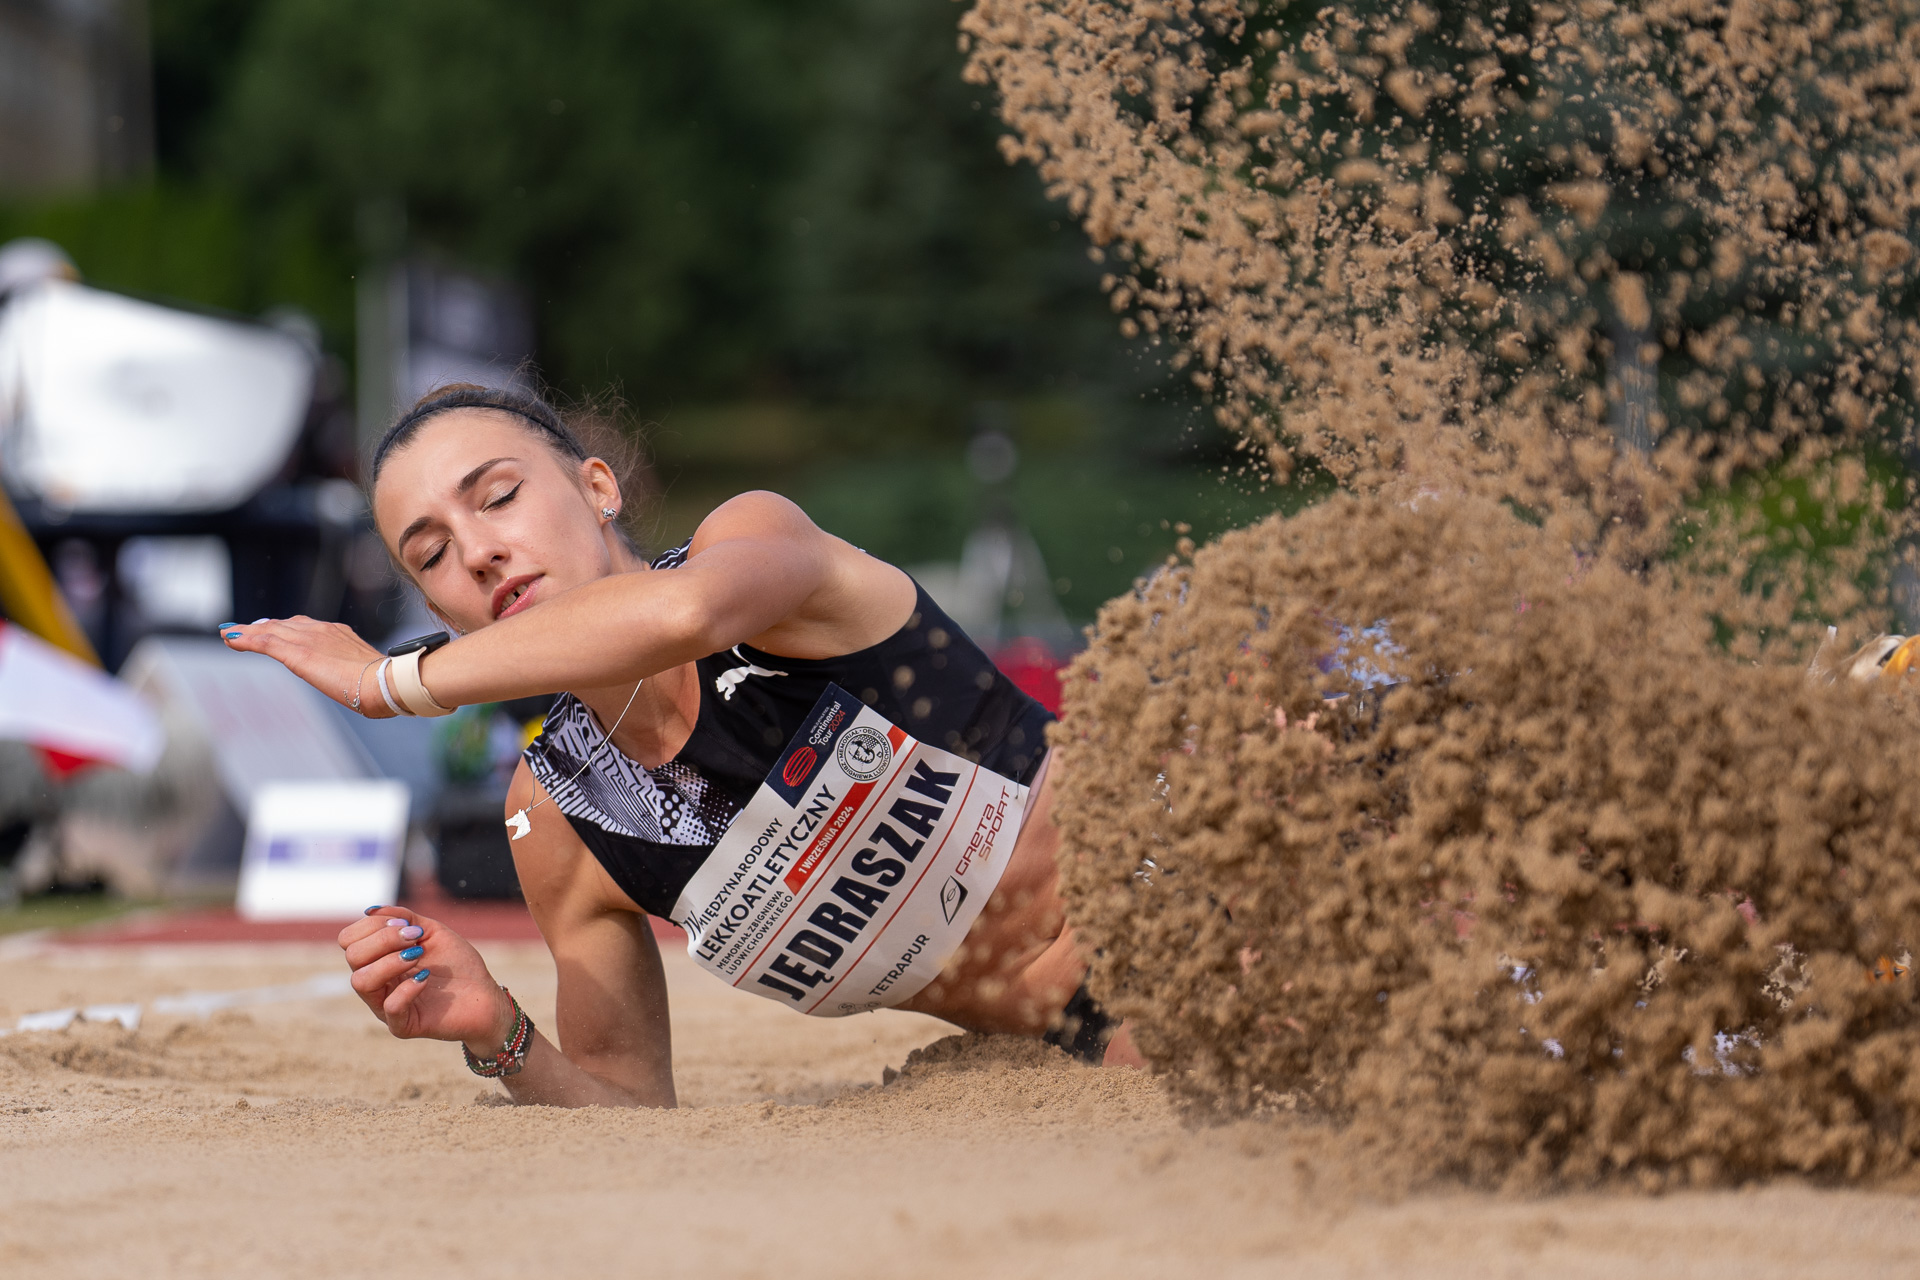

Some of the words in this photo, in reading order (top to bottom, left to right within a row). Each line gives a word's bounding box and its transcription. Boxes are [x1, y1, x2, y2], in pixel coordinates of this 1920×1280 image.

[809, 700, 842, 745] Continental
[817, 729, 834, 746] Tour
[828, 710, 846, 732] 2024
[841, 761, 874, 779] ZBIGNIEWA
[833, 805, 855, 829] 2024
[978, 784, 1010, 862] SPORT
[696, 783, 836, 962] LEKKOATLETYCZNY
[699, 817, 783, 930] MIĘDZYNARODOWY
[798, 867, 808, 875] 1
[801, 827, 840, 870] WRZEŚNIA
[757, 758, 961, 1002] JĘDRASZAK
[716, 931, 752, 970] MEMORIAŁ
[747, 890, 785, 933] ZBIGNIEWA
[725, 895, 793, 976] LUDWICHOWSKIEGO
[868, 934, 931, 996] TETRAPUR
